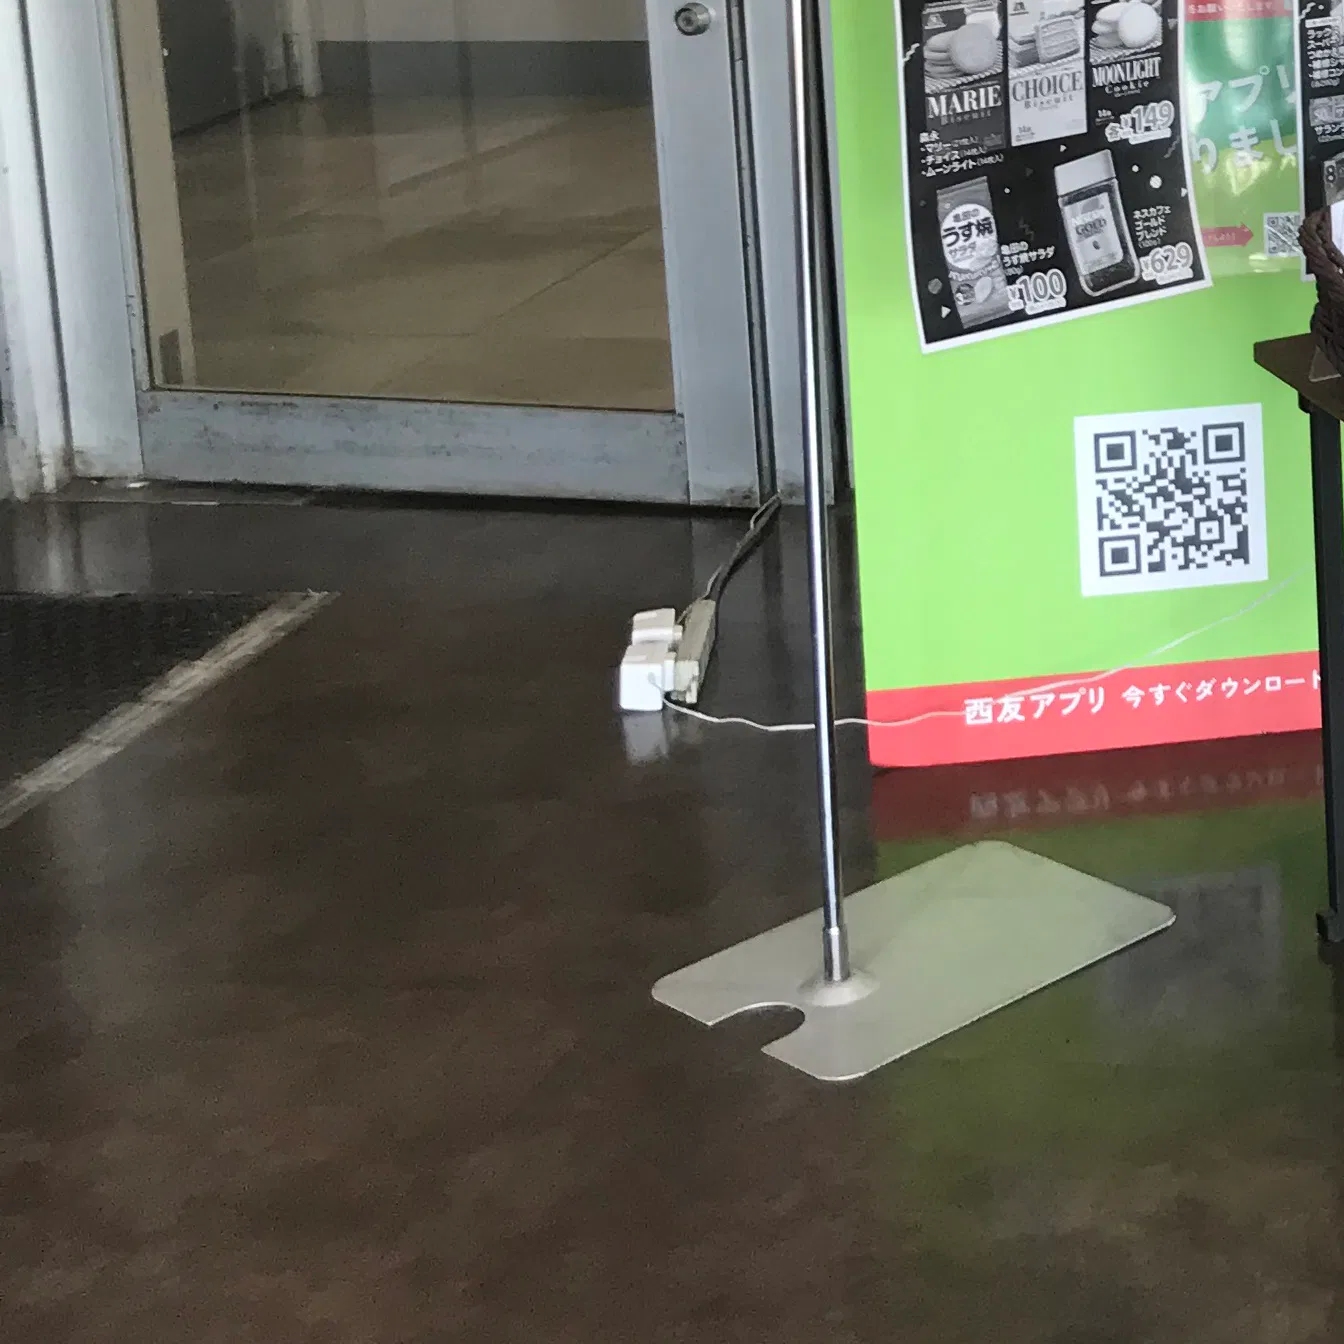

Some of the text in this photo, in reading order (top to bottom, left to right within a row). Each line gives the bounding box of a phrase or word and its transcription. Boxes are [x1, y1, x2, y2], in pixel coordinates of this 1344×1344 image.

[1012, 71, 1083, 102] CHOICE
[1092, 57, 1161, 87] MOONLIGHT
[927, 85, 1001, 118] MARIE
[964, 687, 1104, 726] 西友アプリ
